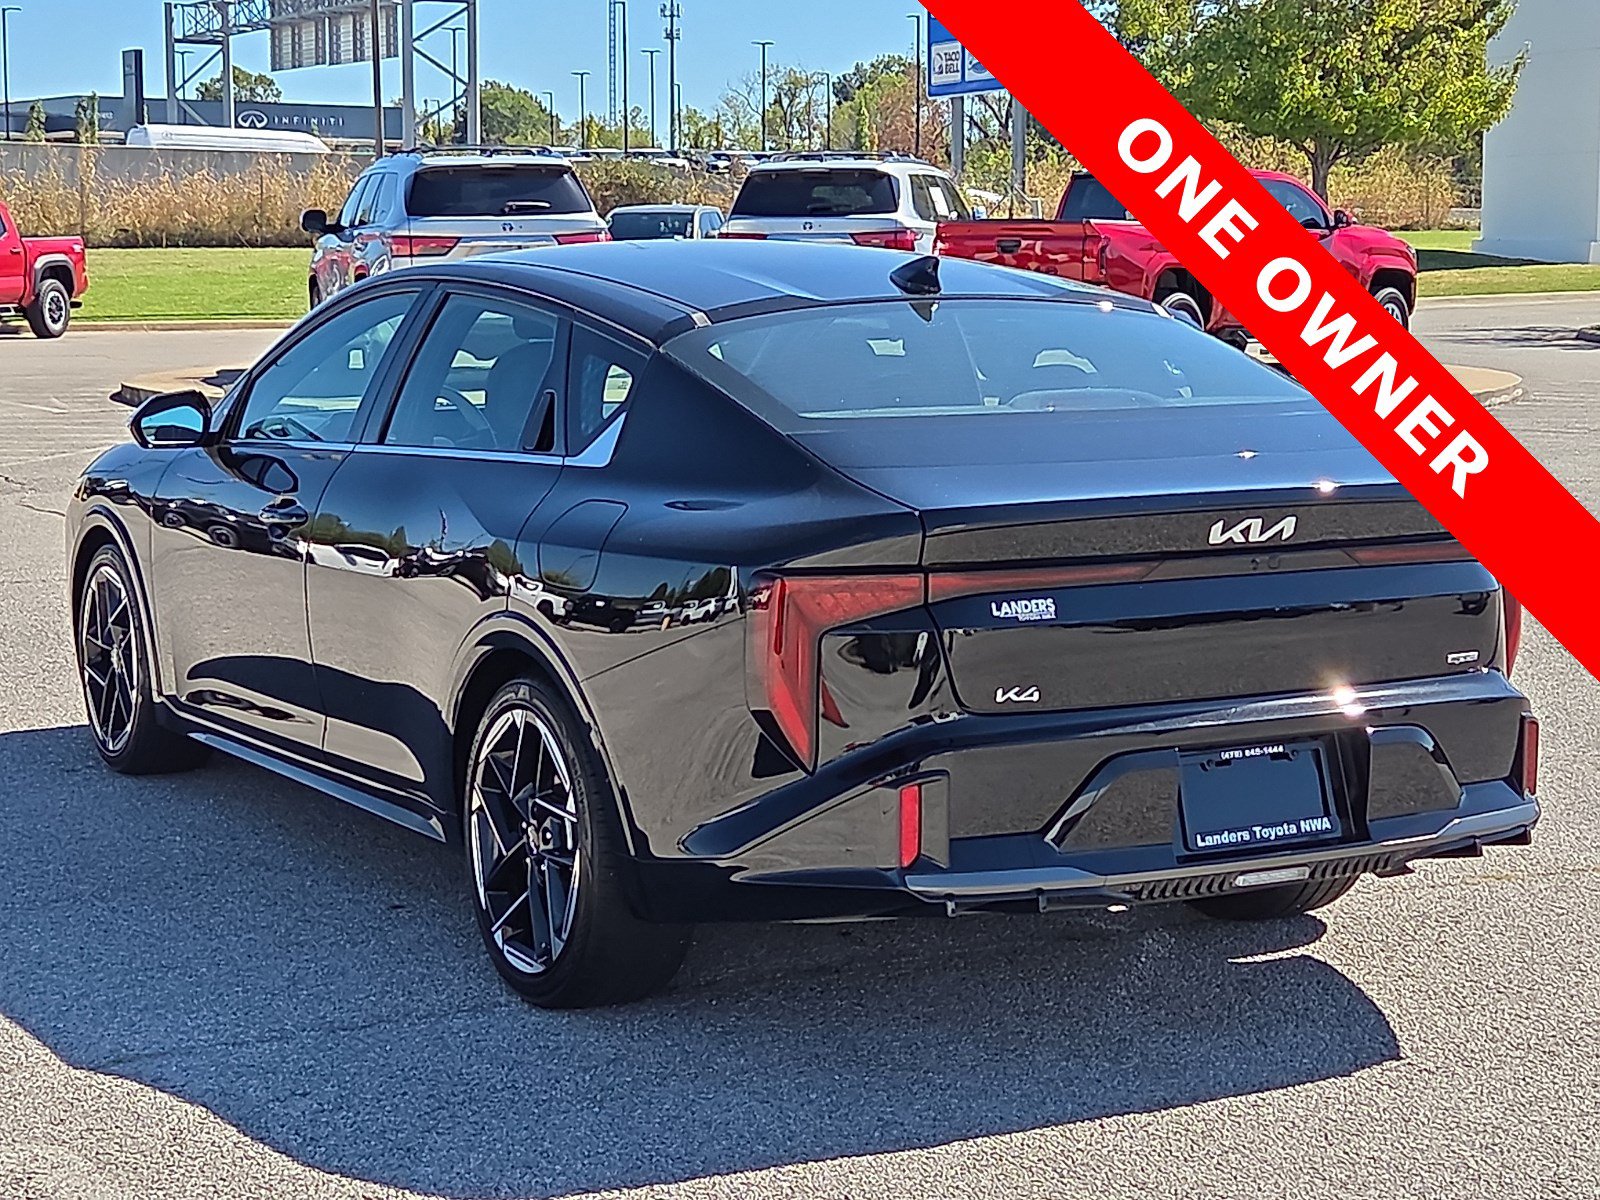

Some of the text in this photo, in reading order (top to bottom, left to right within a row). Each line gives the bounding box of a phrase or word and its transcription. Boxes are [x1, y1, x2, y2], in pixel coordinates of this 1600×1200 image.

[944, 51, 960, 62] TACO
[945, 63, 960, 74] BELL
[272, 115, 344, 126] INFINITI
[1208, 516, 1296, 544] KIA
[991, 598, 1056, 617] LANDERS
[995, 686, 1039, 702] K4
[1196, 817, 1331, 847] Landers Toyota NWA
